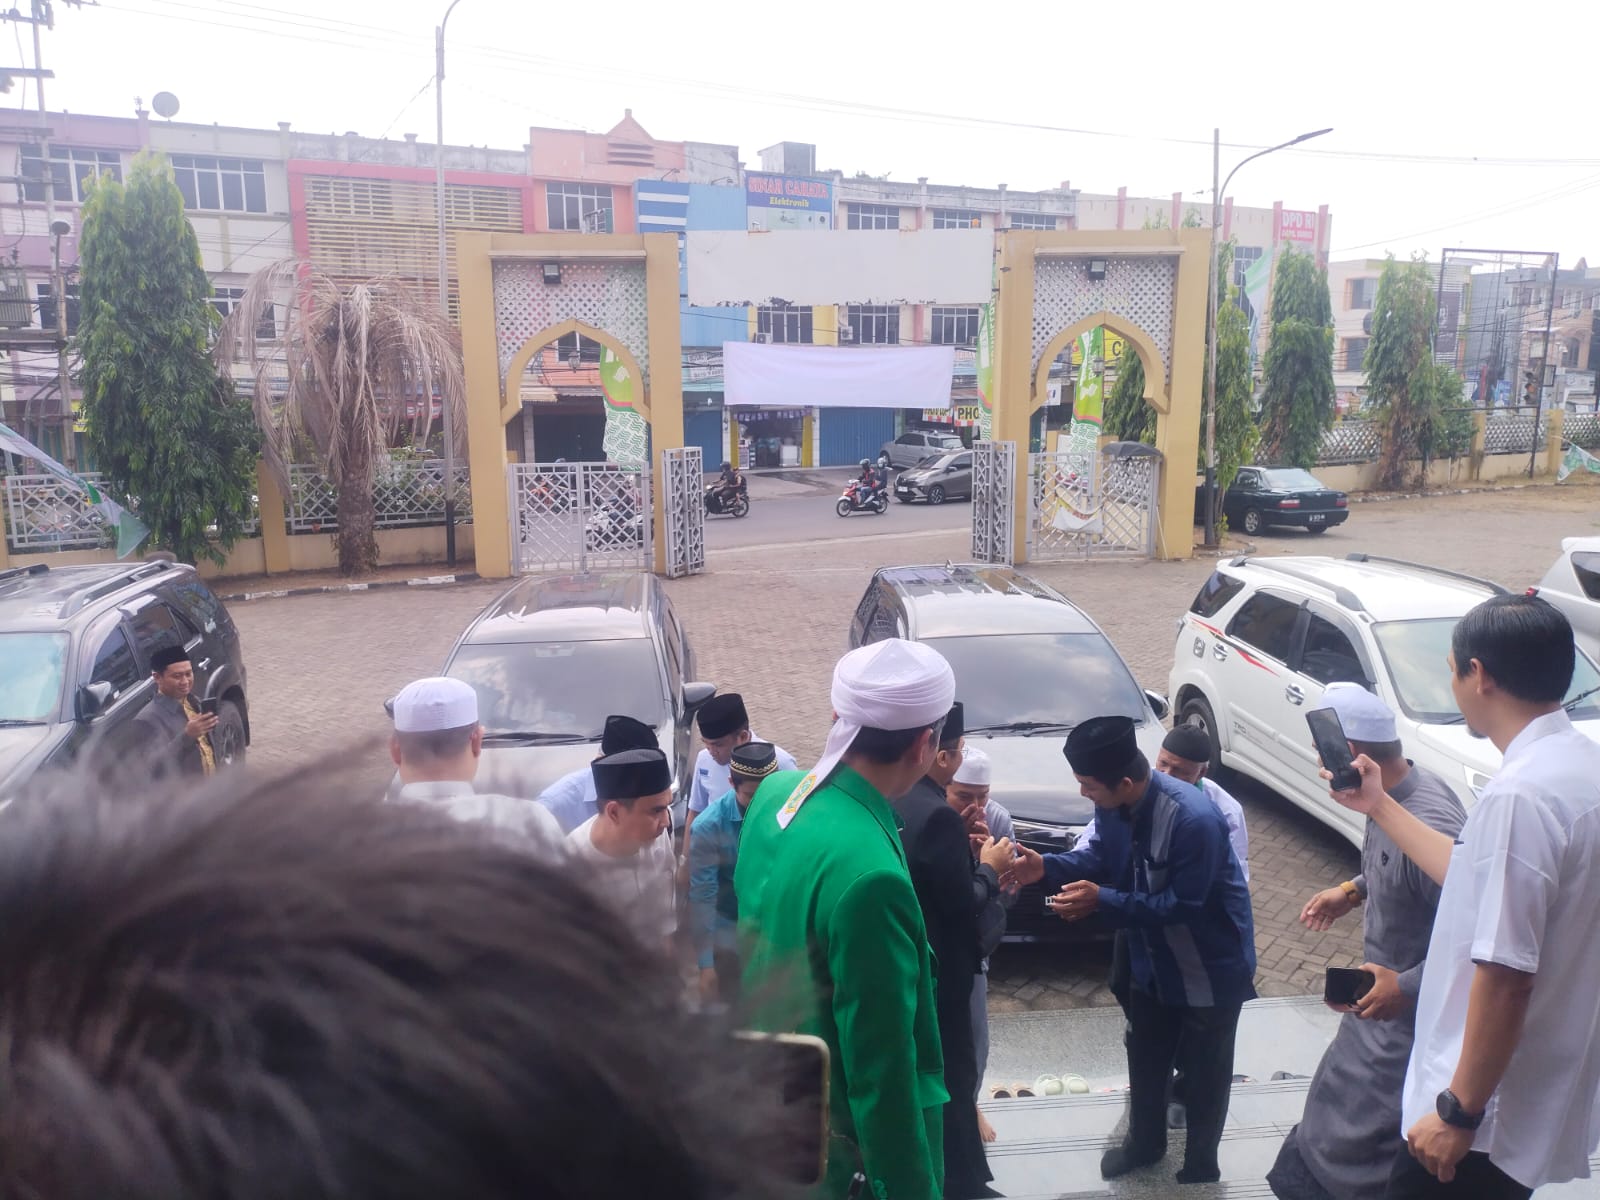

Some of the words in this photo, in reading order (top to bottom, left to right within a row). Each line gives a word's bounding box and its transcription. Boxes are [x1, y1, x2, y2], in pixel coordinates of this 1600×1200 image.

[785, 180, 829, 200] CAHAYA
[769, 196, 810, 209] Elektronik
[1281, 211, 1303, 229] DPD
